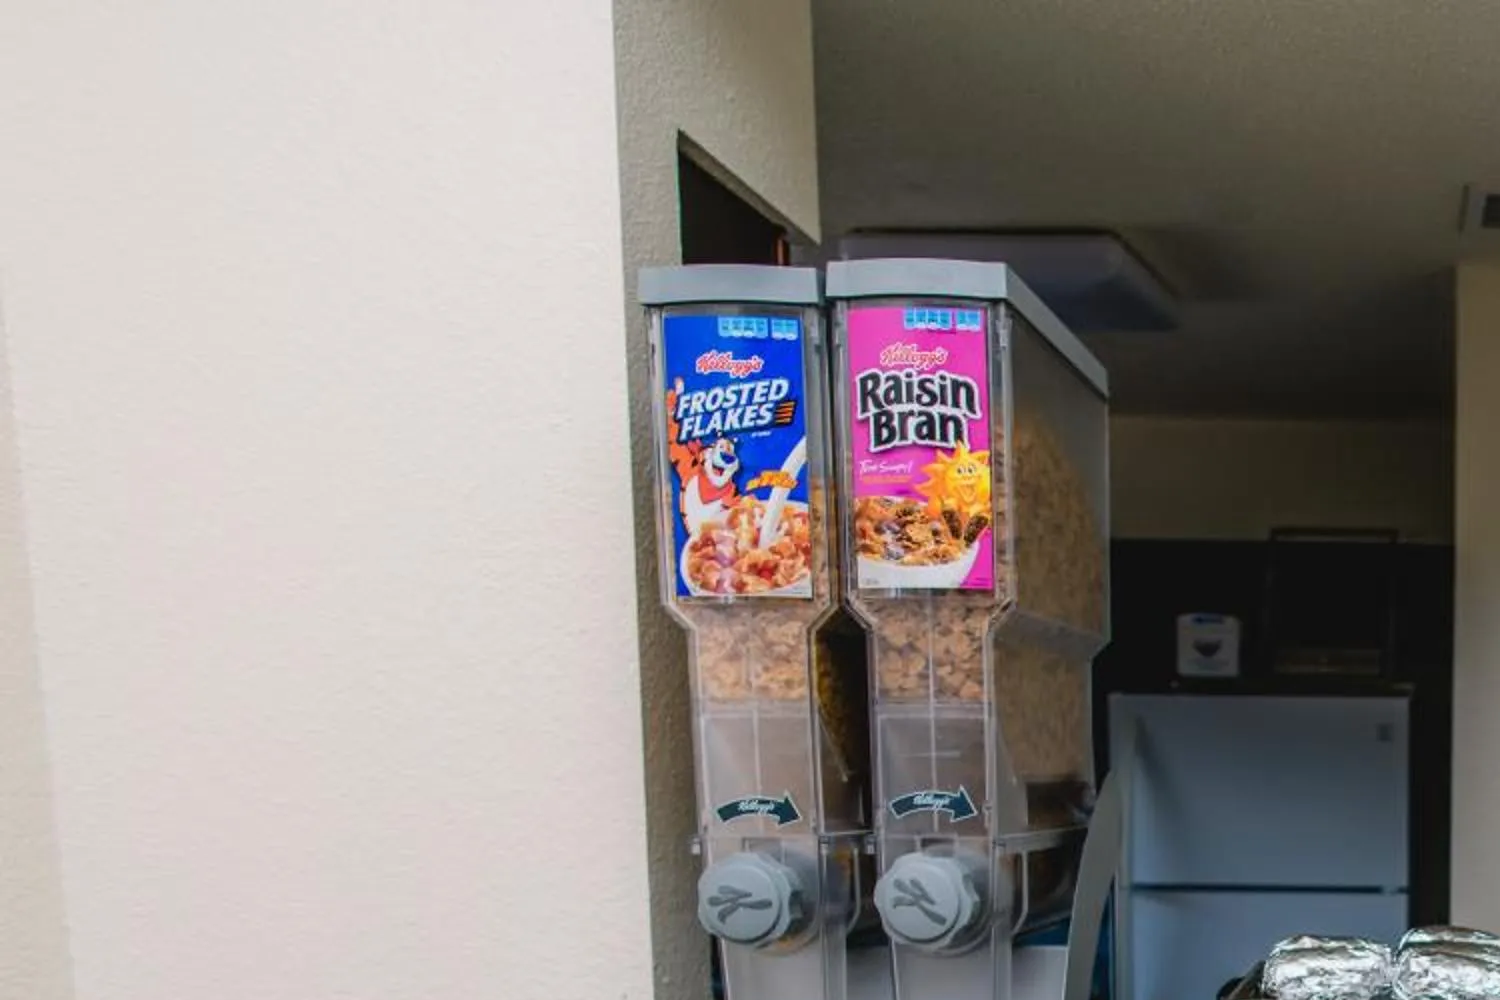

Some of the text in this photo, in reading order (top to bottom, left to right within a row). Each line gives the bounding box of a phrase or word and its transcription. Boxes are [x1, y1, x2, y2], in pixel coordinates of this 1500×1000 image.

[675, 377, 790, 419] FROSTED
[857, 369, 979, 417] Raisin
[680, 402, 774, 441] FLAKES
[872, 407, 967, 451] Bran
